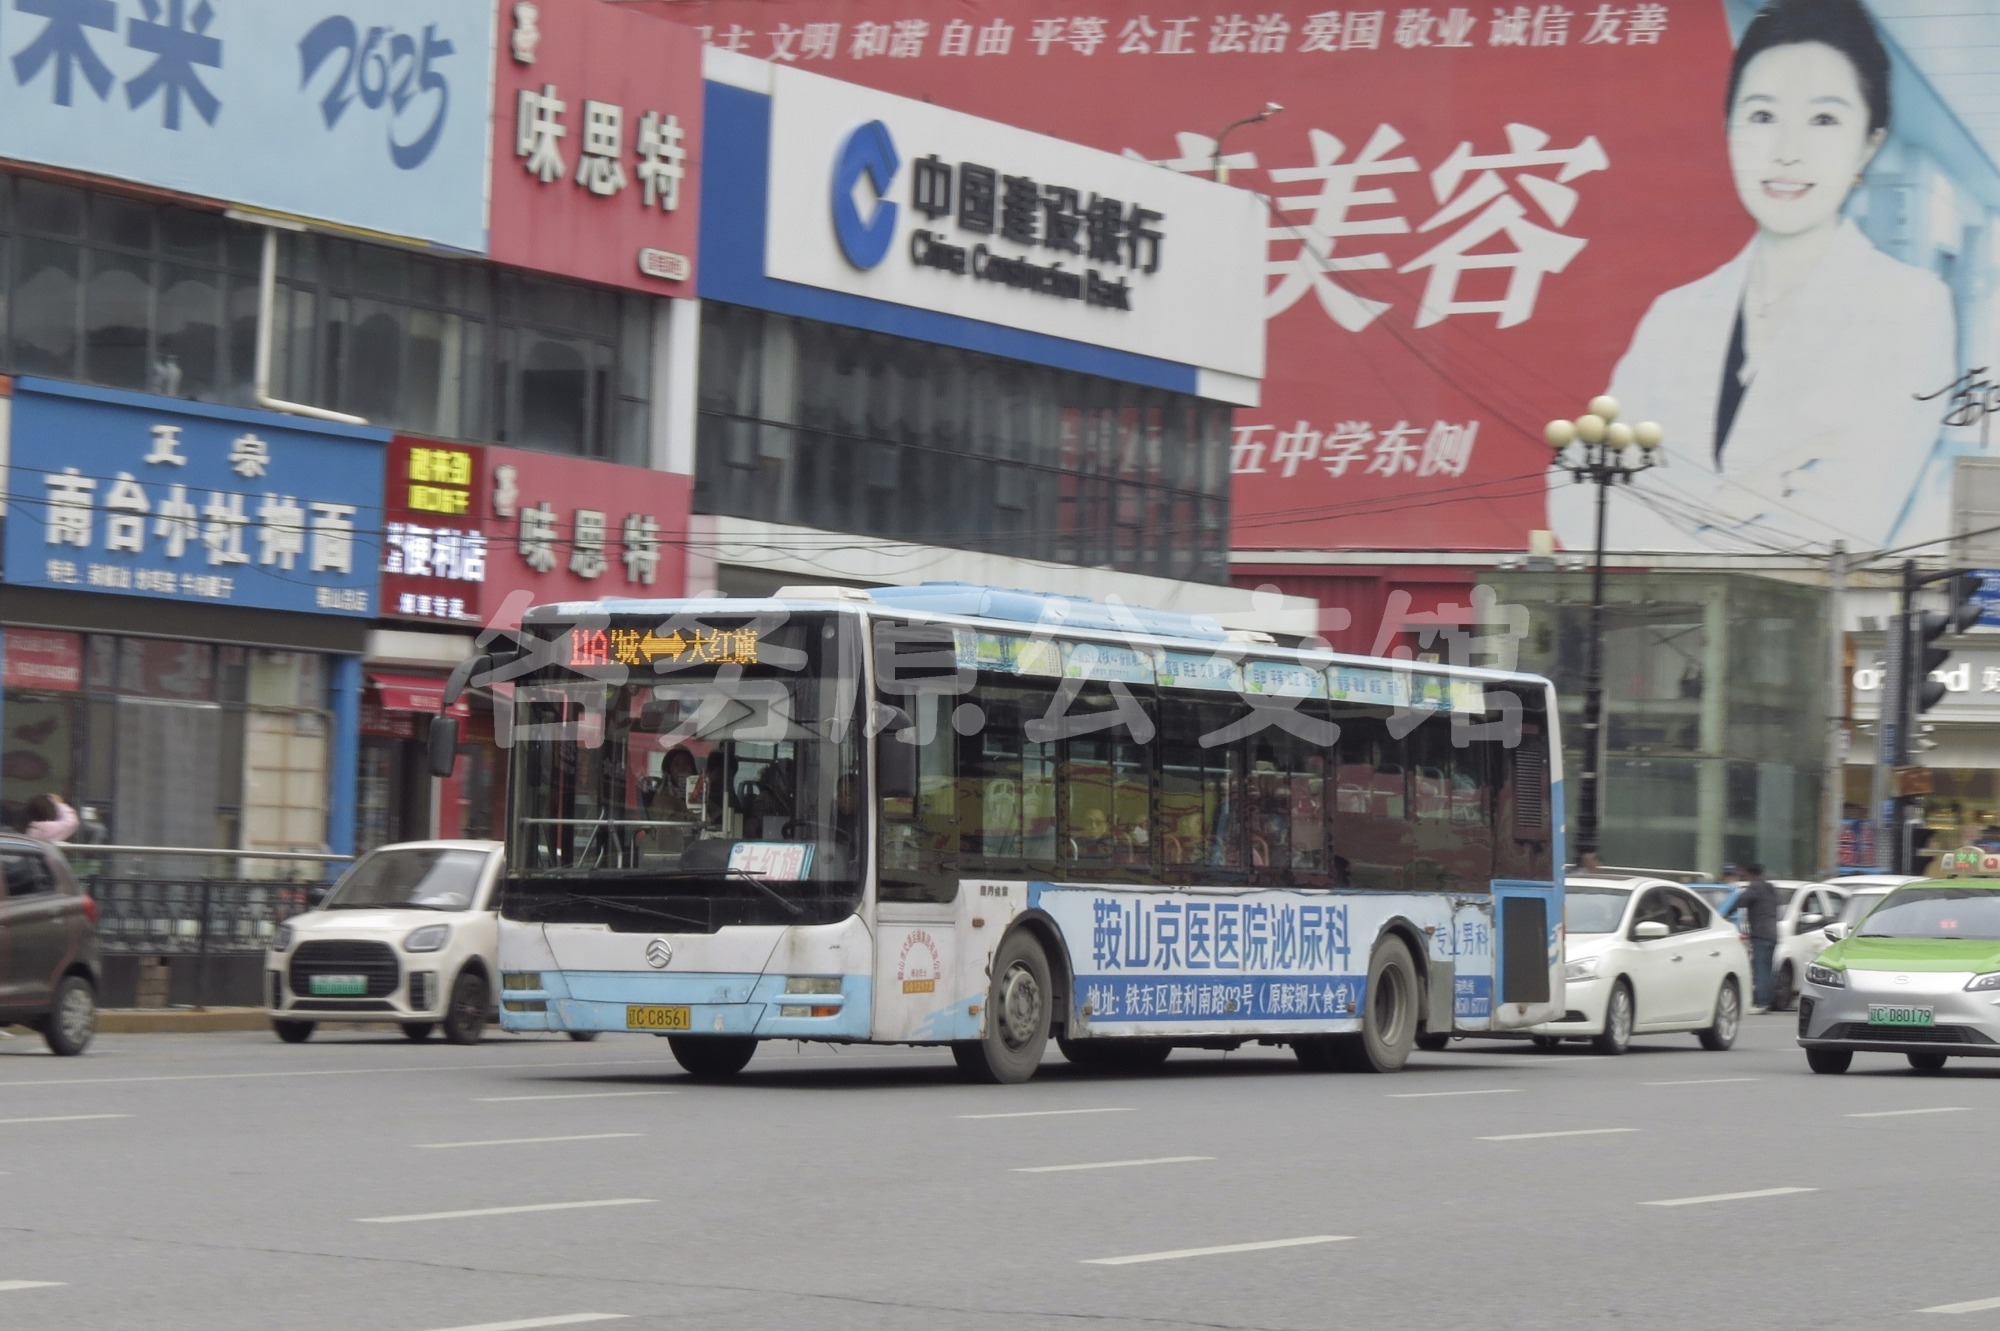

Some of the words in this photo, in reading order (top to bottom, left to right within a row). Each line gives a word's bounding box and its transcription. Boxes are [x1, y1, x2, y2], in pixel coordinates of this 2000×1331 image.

[766, 22, 841, 62] 文明
[848, 18, 930, 61] 和谐
[939, 18, 1015, 58] 自由
[1031, 15, 1109, 57] 平等
[1117, 15, 1199, 55] 公正
[1208, 13, 1291, 54] 法治
[1298, 10, 1386, 52] 爱国
[1393, 7, 1478, 50] 敬业
[1488, 5, 1573, 47] 诚信
[1582, 3, 1669, 46] 友善
[296, 14, 458, 171] 2025
[516, 83, 687, 211] 味思特
[912, 154, 1165, 275] 中国建设银行
[910, 228, 966, 276] China
[973, 243, 1083, 300] Construction
[1084, 268, 1132, 311] Bank
[144, 423, 271, 477] 正宗
[1230, 419, 1480, 478] 五中学东侧
[519, 501, 661, 586] 味思特
[570, 629, 608, 666] 11A
[686, 628, 759, 665] 大红旗
[740, 845, 802, 880] 大红旗
[1092, 898, 1351, 971] 鞍山京医医院泌尿科
[1434, 921, 1489, 956] 专业男科
